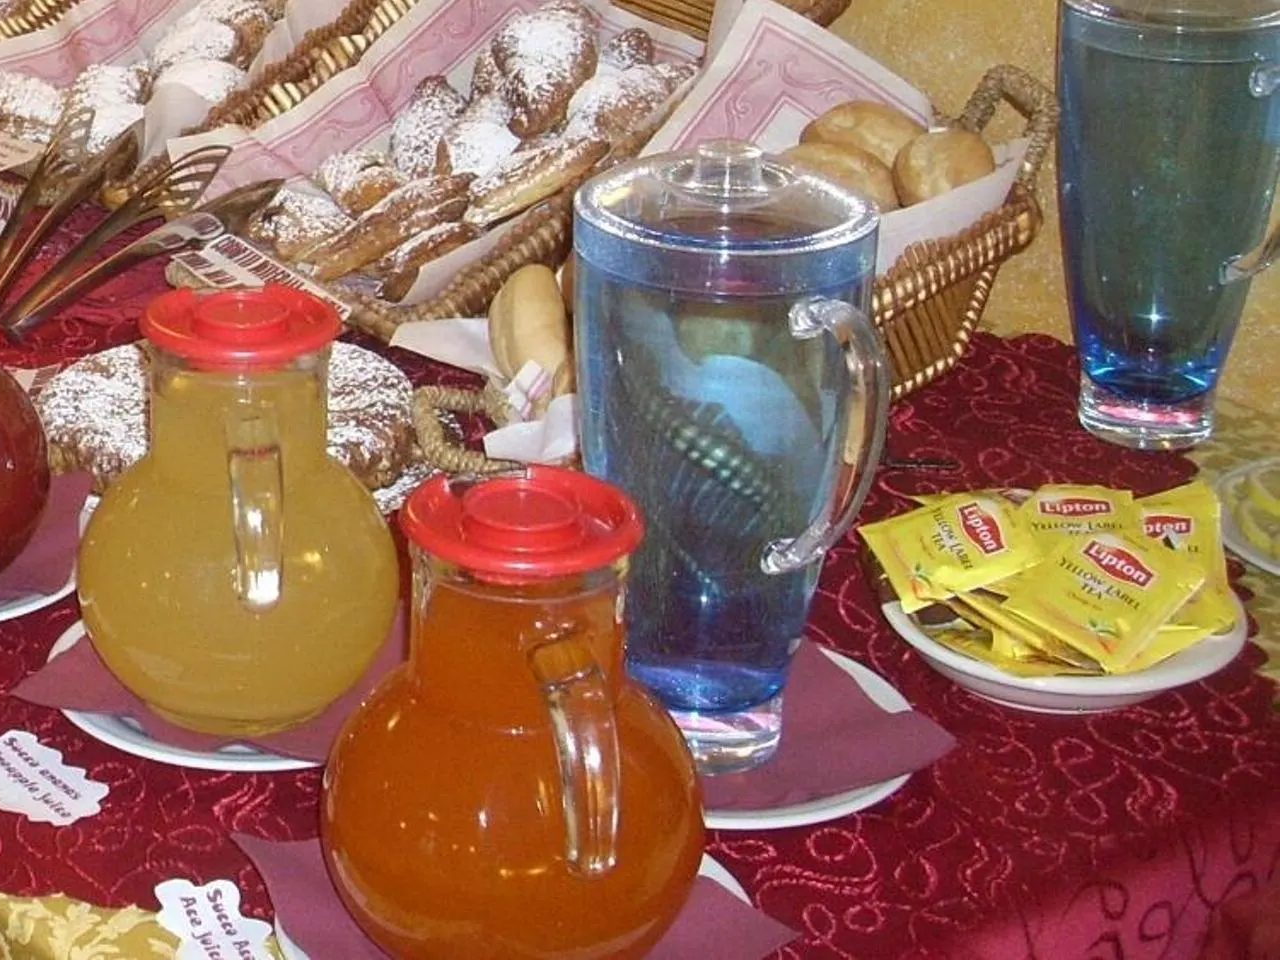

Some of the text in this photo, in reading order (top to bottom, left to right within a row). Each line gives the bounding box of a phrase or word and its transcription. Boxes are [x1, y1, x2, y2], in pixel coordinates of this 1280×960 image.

[964, 506, 998, 551] Lipton
[1045, 501, 1107, 514] Lipton
[1146, 519, 1188, 535] pton
[1058, 556, 1105, 586] YELLOW
[1107, 585, 1141, 611] LABEL
[1088, 543, 1148, 584] Lipton
[1081, 583, 1103, 600] TEA
[3, 737, 82, 801] Succo ananas
[179, 896, 224, 960] Ace juic
[206, 887, 238, 936] Succo
